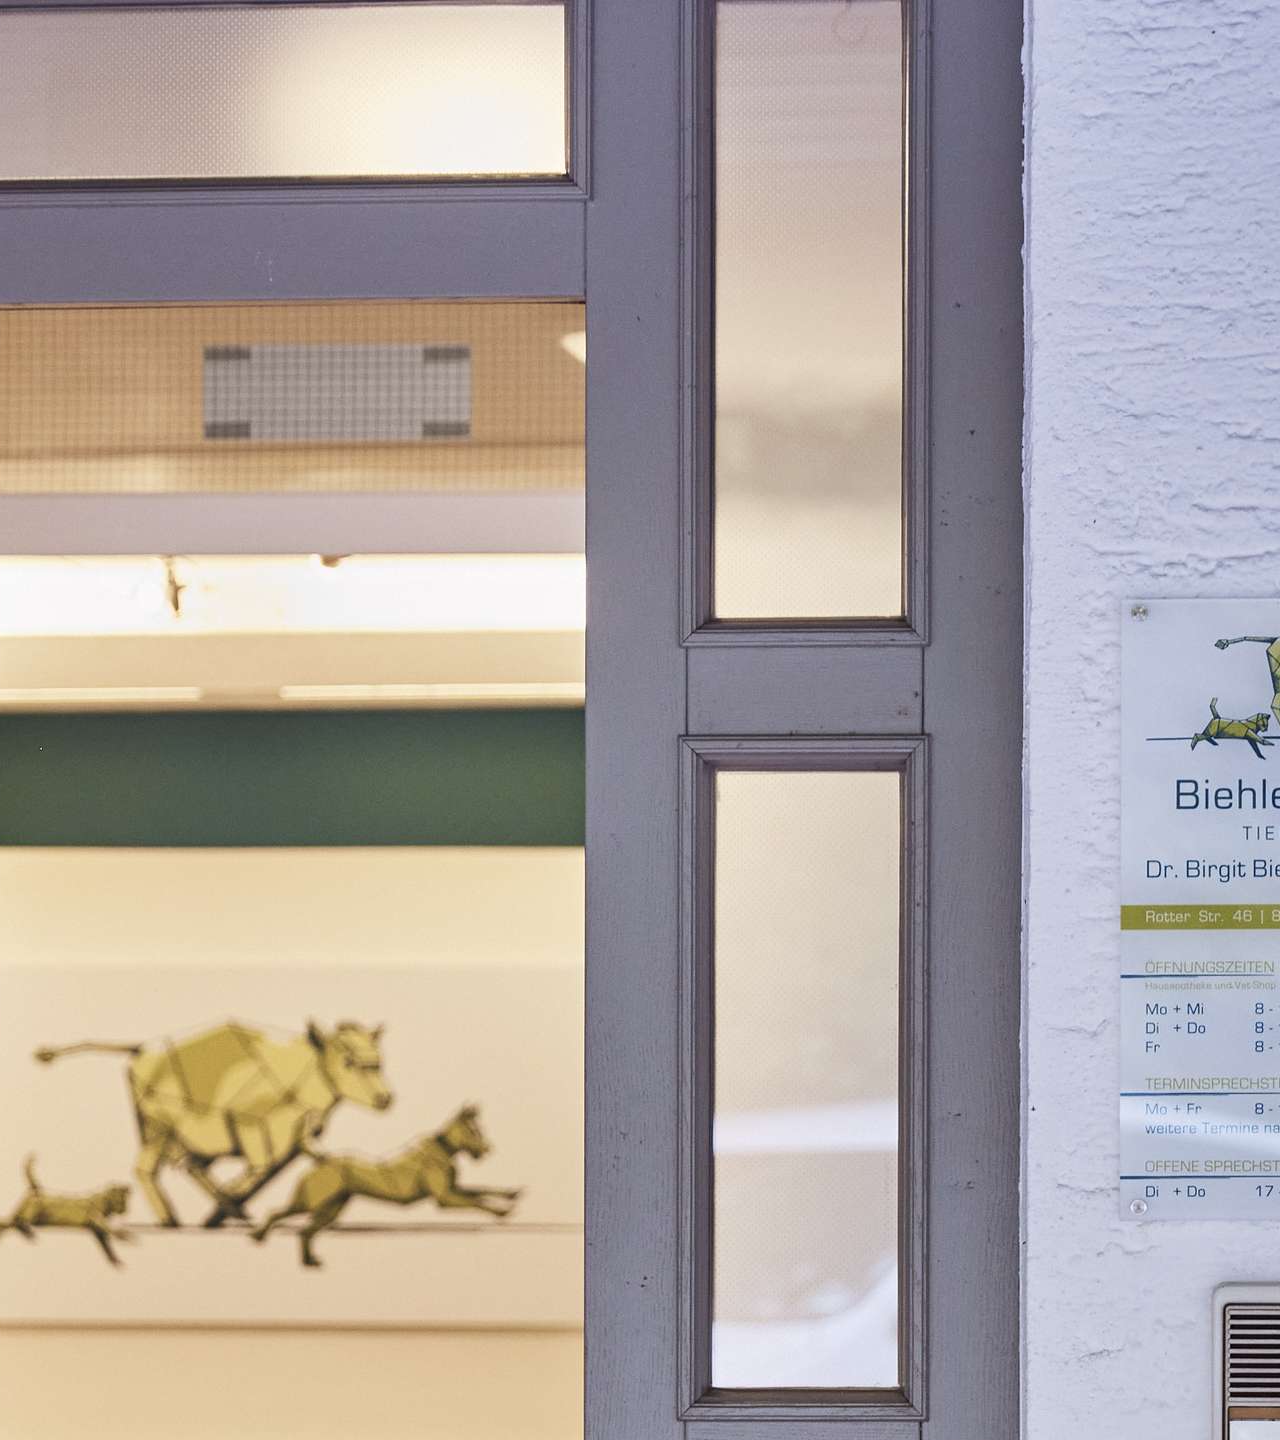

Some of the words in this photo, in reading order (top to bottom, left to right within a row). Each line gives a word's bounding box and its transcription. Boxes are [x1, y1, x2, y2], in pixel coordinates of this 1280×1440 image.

[1146, 860, 1178, 879] Dr.
[1186, 859, 1246, 882] Birgit
[1145, 910, 1191, 923] Rotter
[1198, 910, 1224, 923] Str.
[1232, 910, 1253, 922] 46
[1144, 959, 1275, 974] ÖFFNUNGSZEITEN
[1145, 1004, 1168, 1016] Mo
[1187, 1003, 1204, 1015] Mi
[1255, 1003, 1264, 1015] 8
[1145, 1022, 1160, 1035] Di
[1187, 1022, 1206, 1034] Do
[1255, 1022, 1264, 1034] 8
[1145, 1041, 1161, 1053] Fr
[1255, 1041, 1264, 1053] 8
[1145, 1103, 1168, 1115] Mo
[1187, 1103, 1202, 1114] Fr
[1255, 1103, 1264, 1115] 8
[1145, 1122, 1197, 1135] weitere
[1202, 1122, 1260, 1134] Termine
[1144, 1160, 1199, 1173] OFFENE
[1145, 1186, 1159, 1198] Di
[1187, 1186, 1206, 1198] Do
[1256, 1185, 1274, 1197] 17
